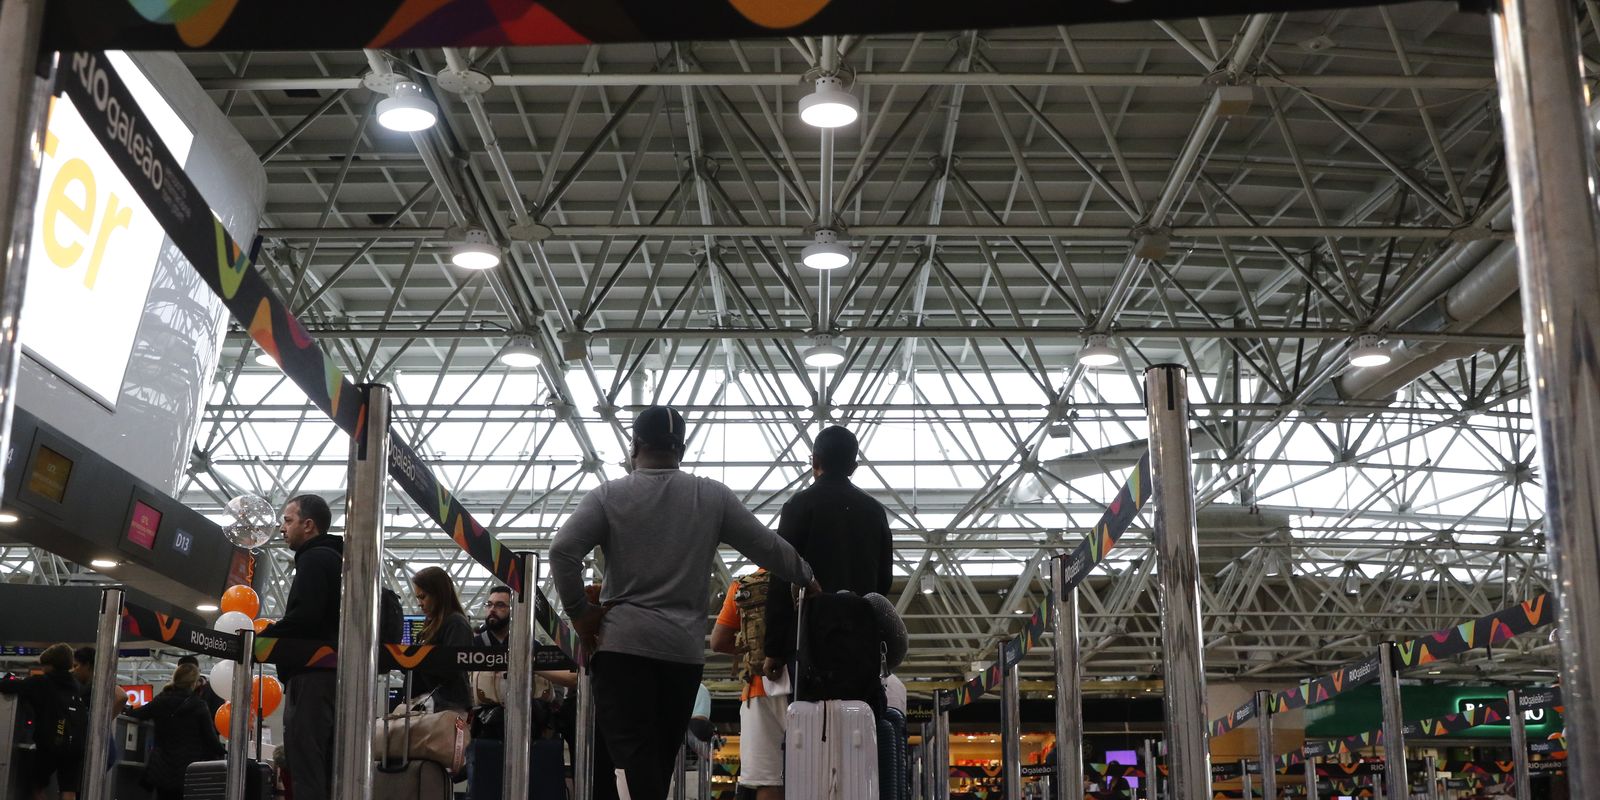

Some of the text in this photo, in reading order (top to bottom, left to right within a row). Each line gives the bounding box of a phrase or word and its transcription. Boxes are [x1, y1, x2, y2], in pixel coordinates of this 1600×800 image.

[73, 52, 163, 190] RIOgaleão
[176, 533, 190, 551] D13
[191, 631, 227, 651] RIOgaleão
[457, 652, 510, 667] RIOgal
[125, 690, 150, 705] OL
